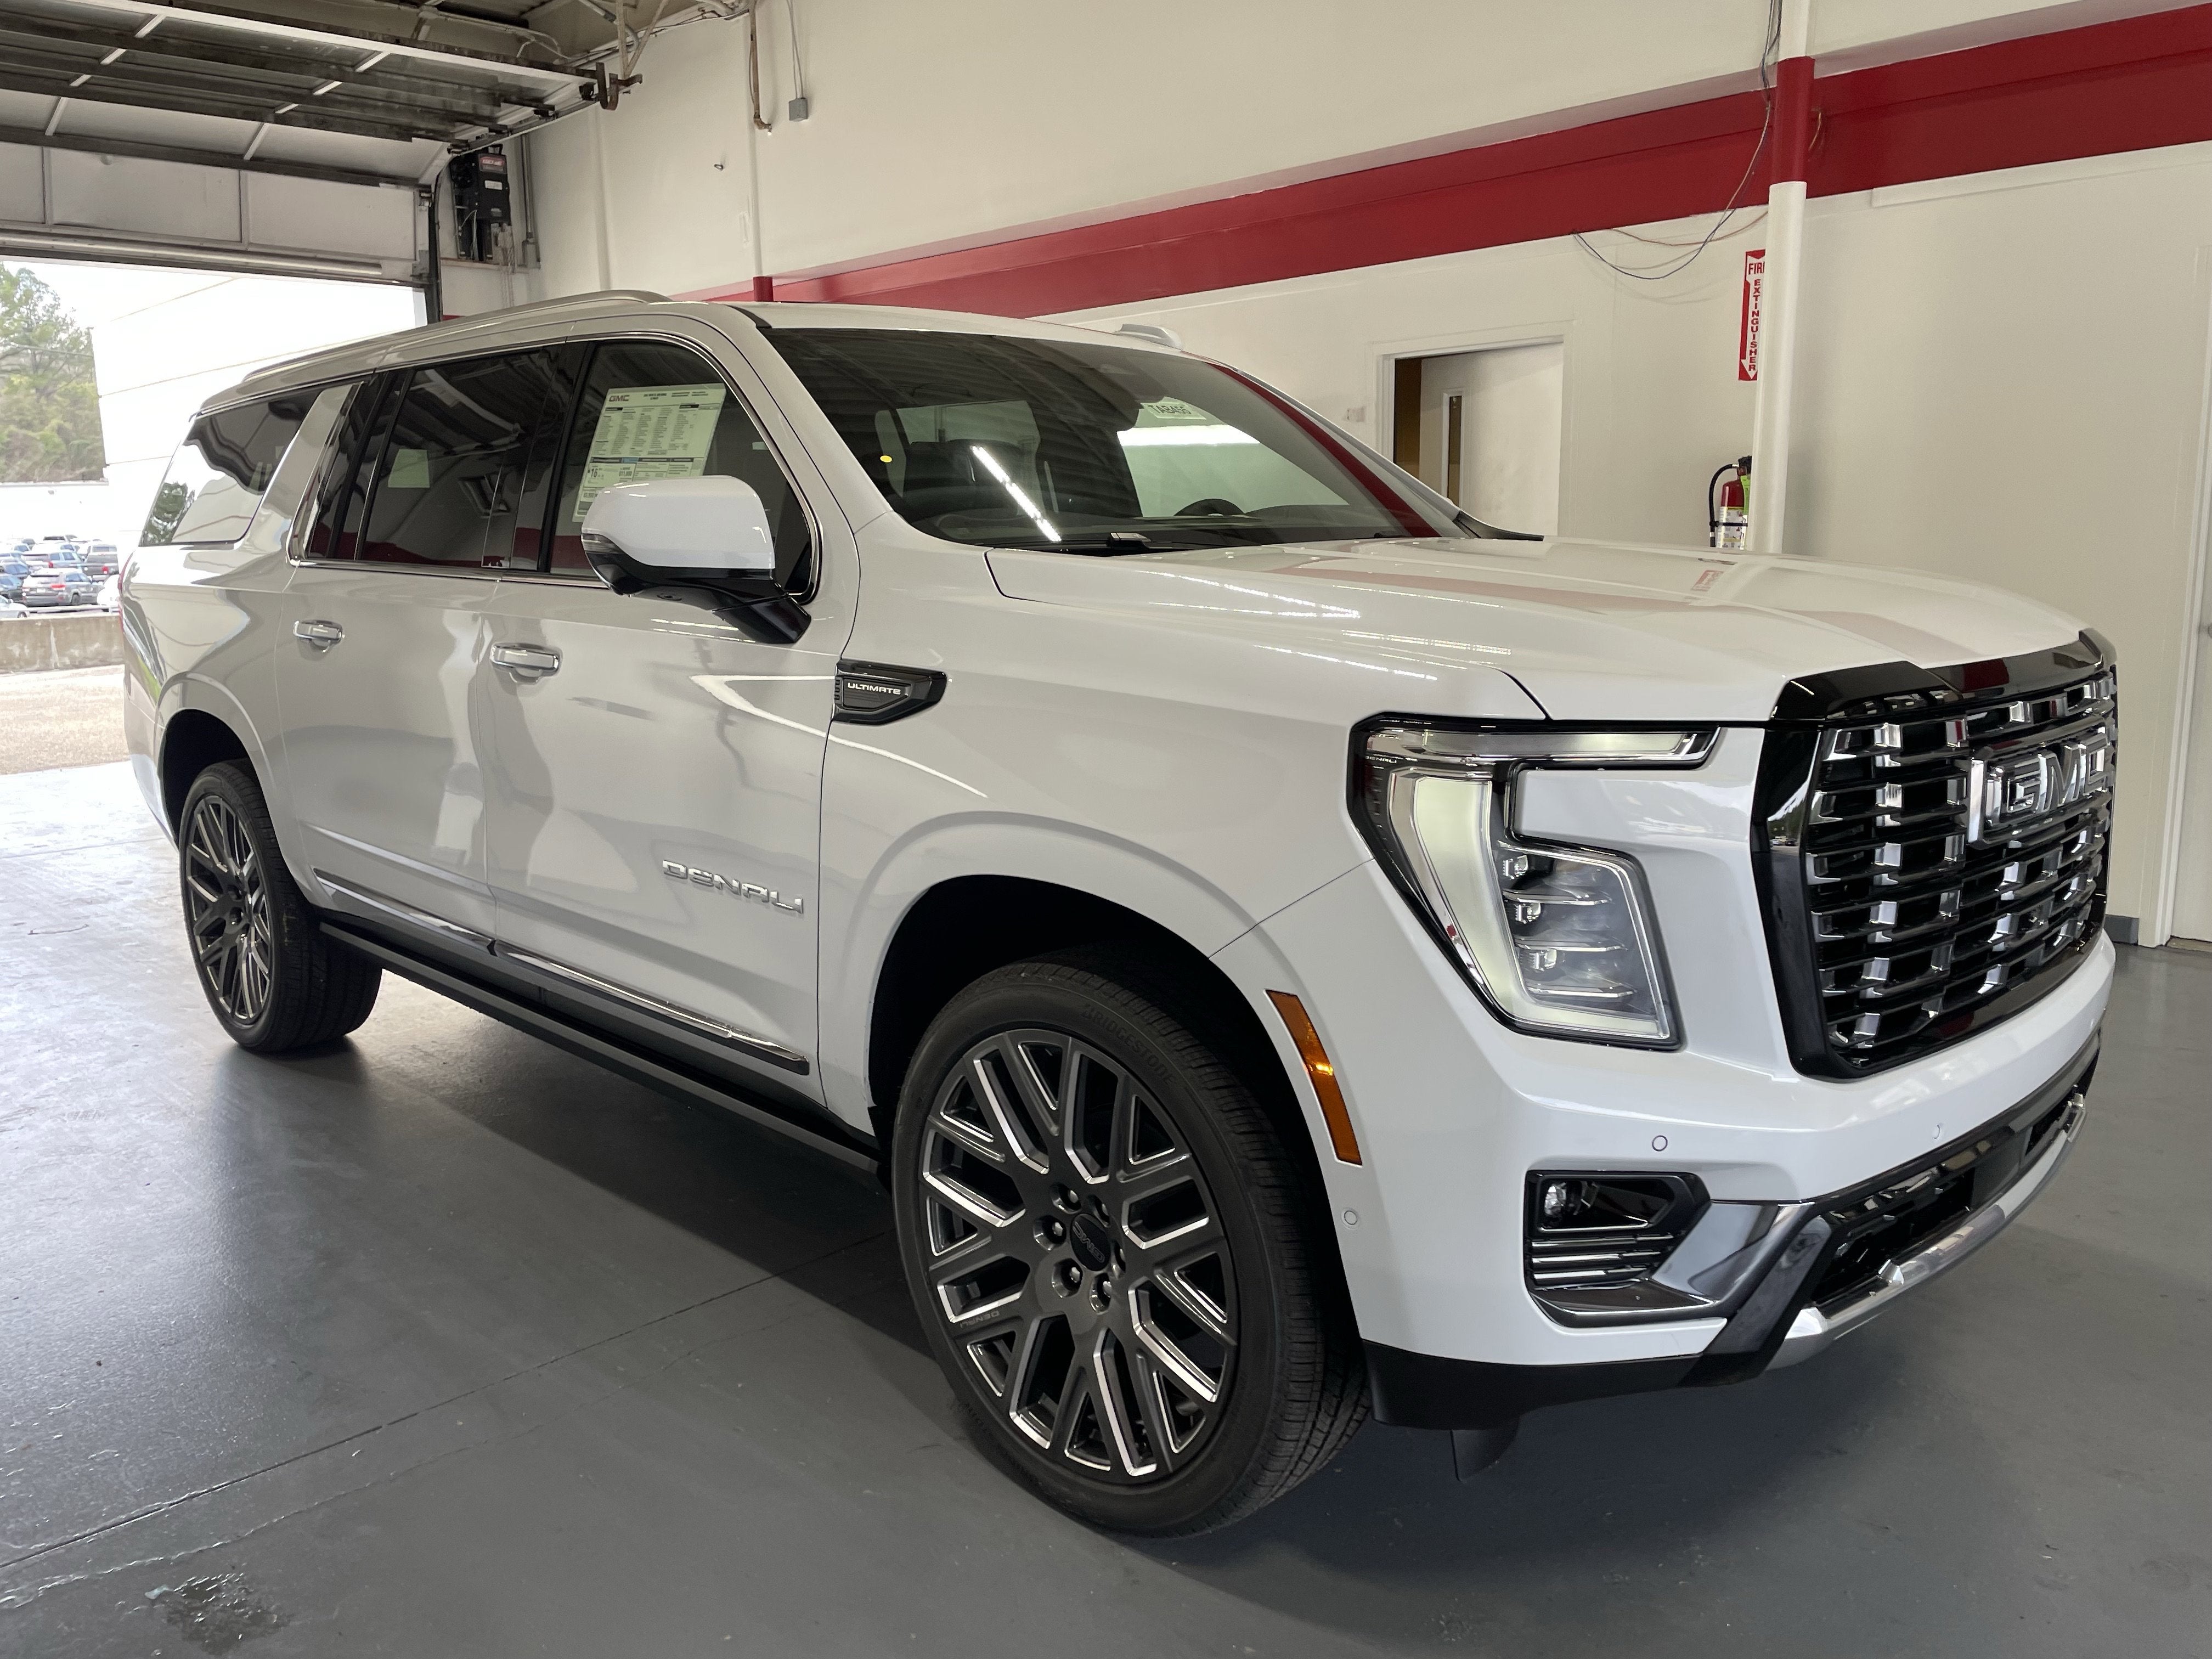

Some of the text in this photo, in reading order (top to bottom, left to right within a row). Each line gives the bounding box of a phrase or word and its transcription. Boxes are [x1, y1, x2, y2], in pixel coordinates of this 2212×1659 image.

[1748, 279, 1761, 371] EXTINGUISHER
[848, 682, 901, 695] ULTIMATE
[1982, 733, 2108, 827] GMC
[662, 860, 803, 915] DENALI
[1080, 1005, 1176, 1086] BRIDGESTONE
[1073, 1221, 1105, 1263] GMC
